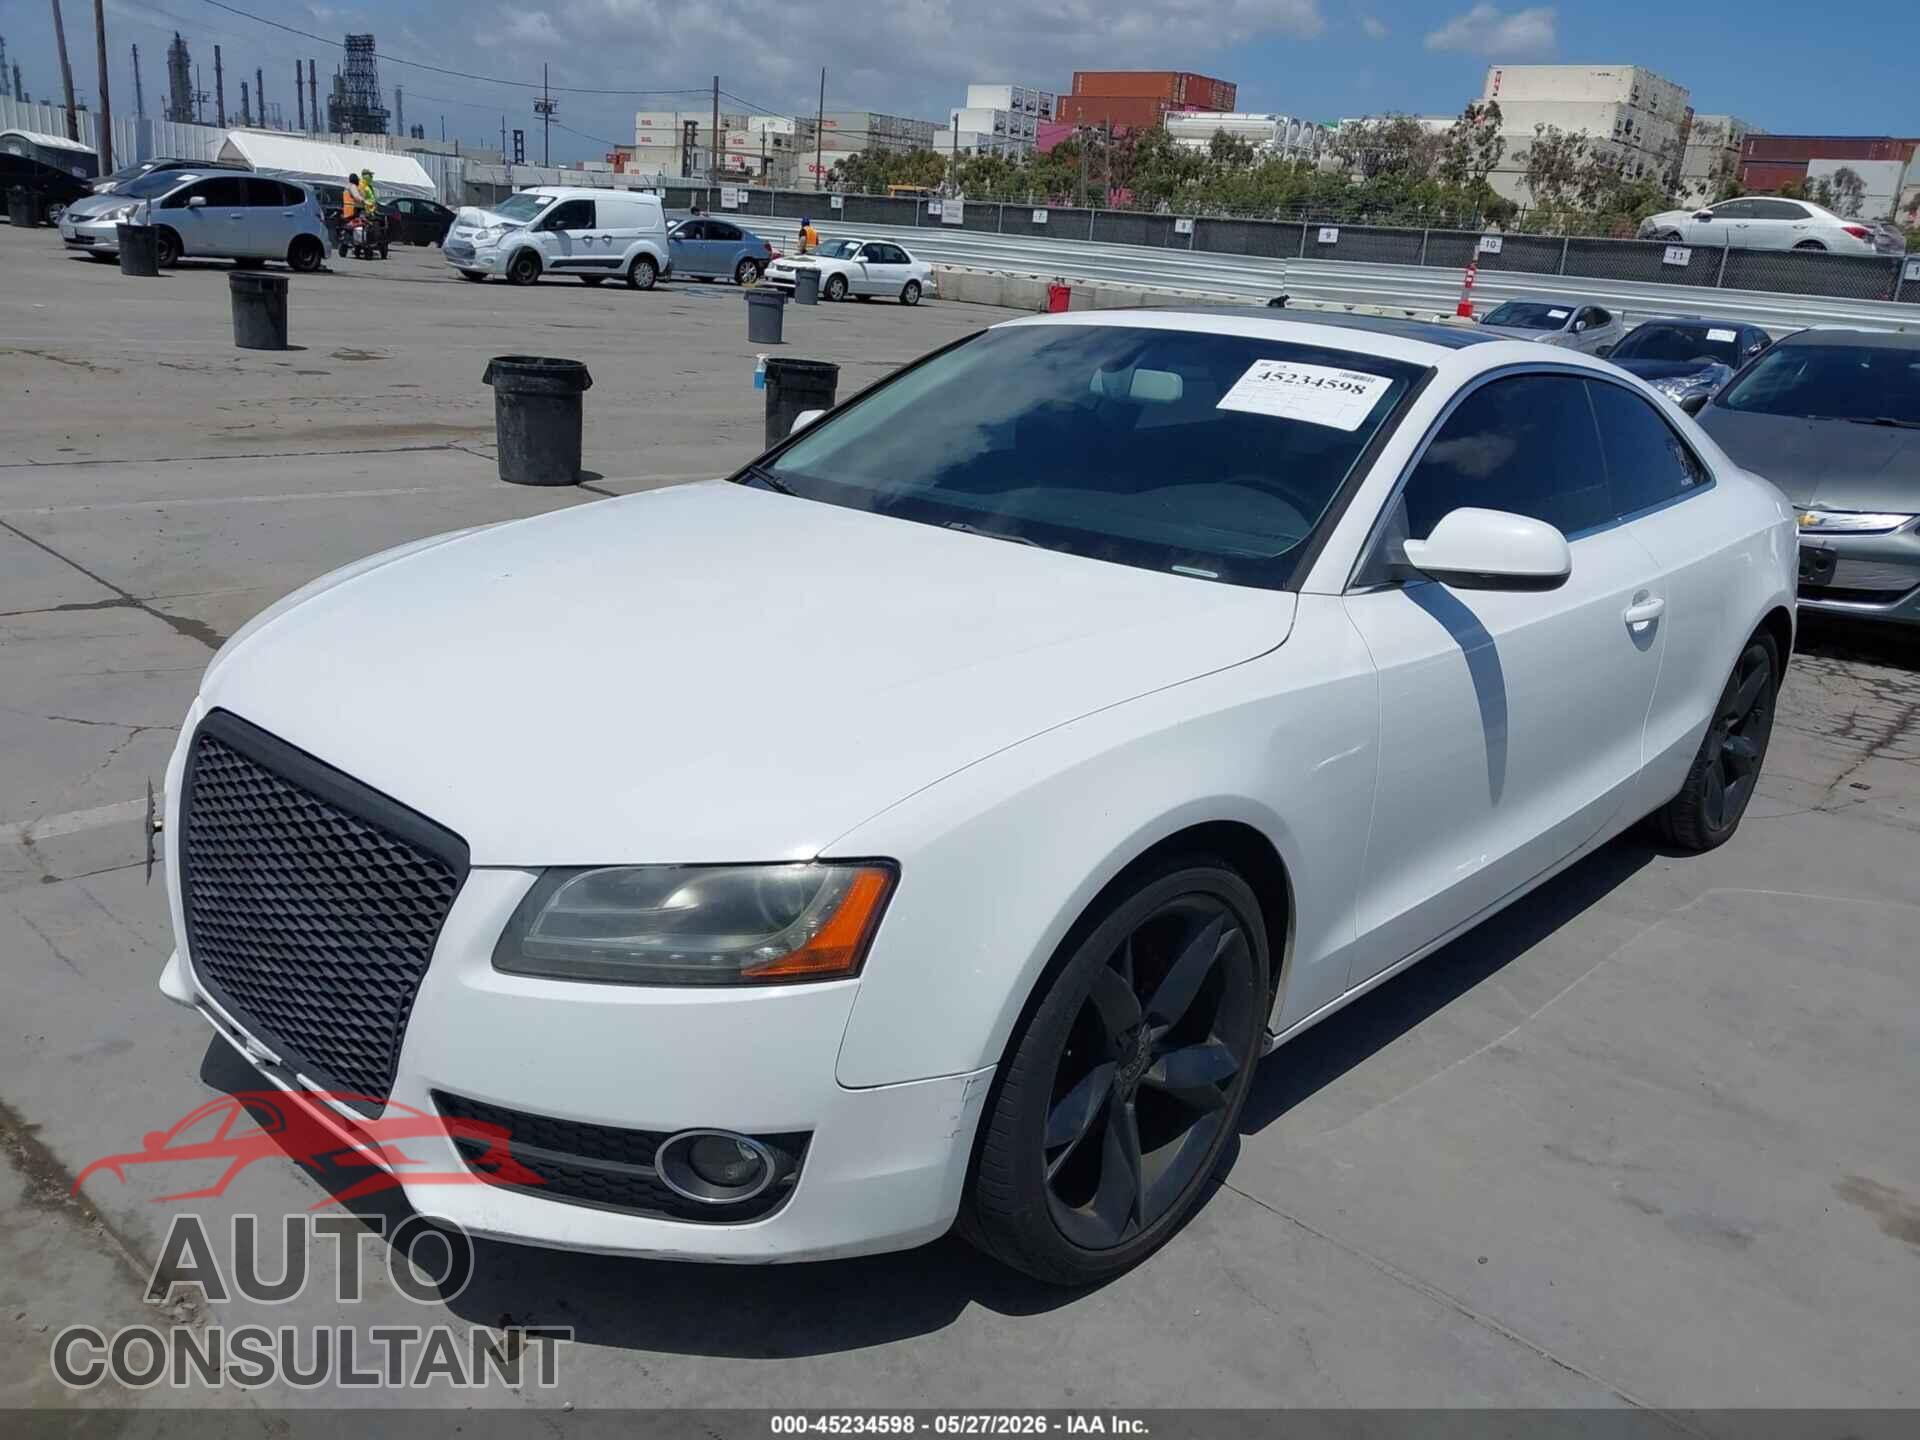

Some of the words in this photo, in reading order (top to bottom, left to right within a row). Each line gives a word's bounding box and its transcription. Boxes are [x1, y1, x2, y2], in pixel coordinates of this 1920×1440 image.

[1486, 240, 1497, 248] 10
[1673, 251, 1684, 260] 11
[1257, 371, 1367, 395] 45234598
